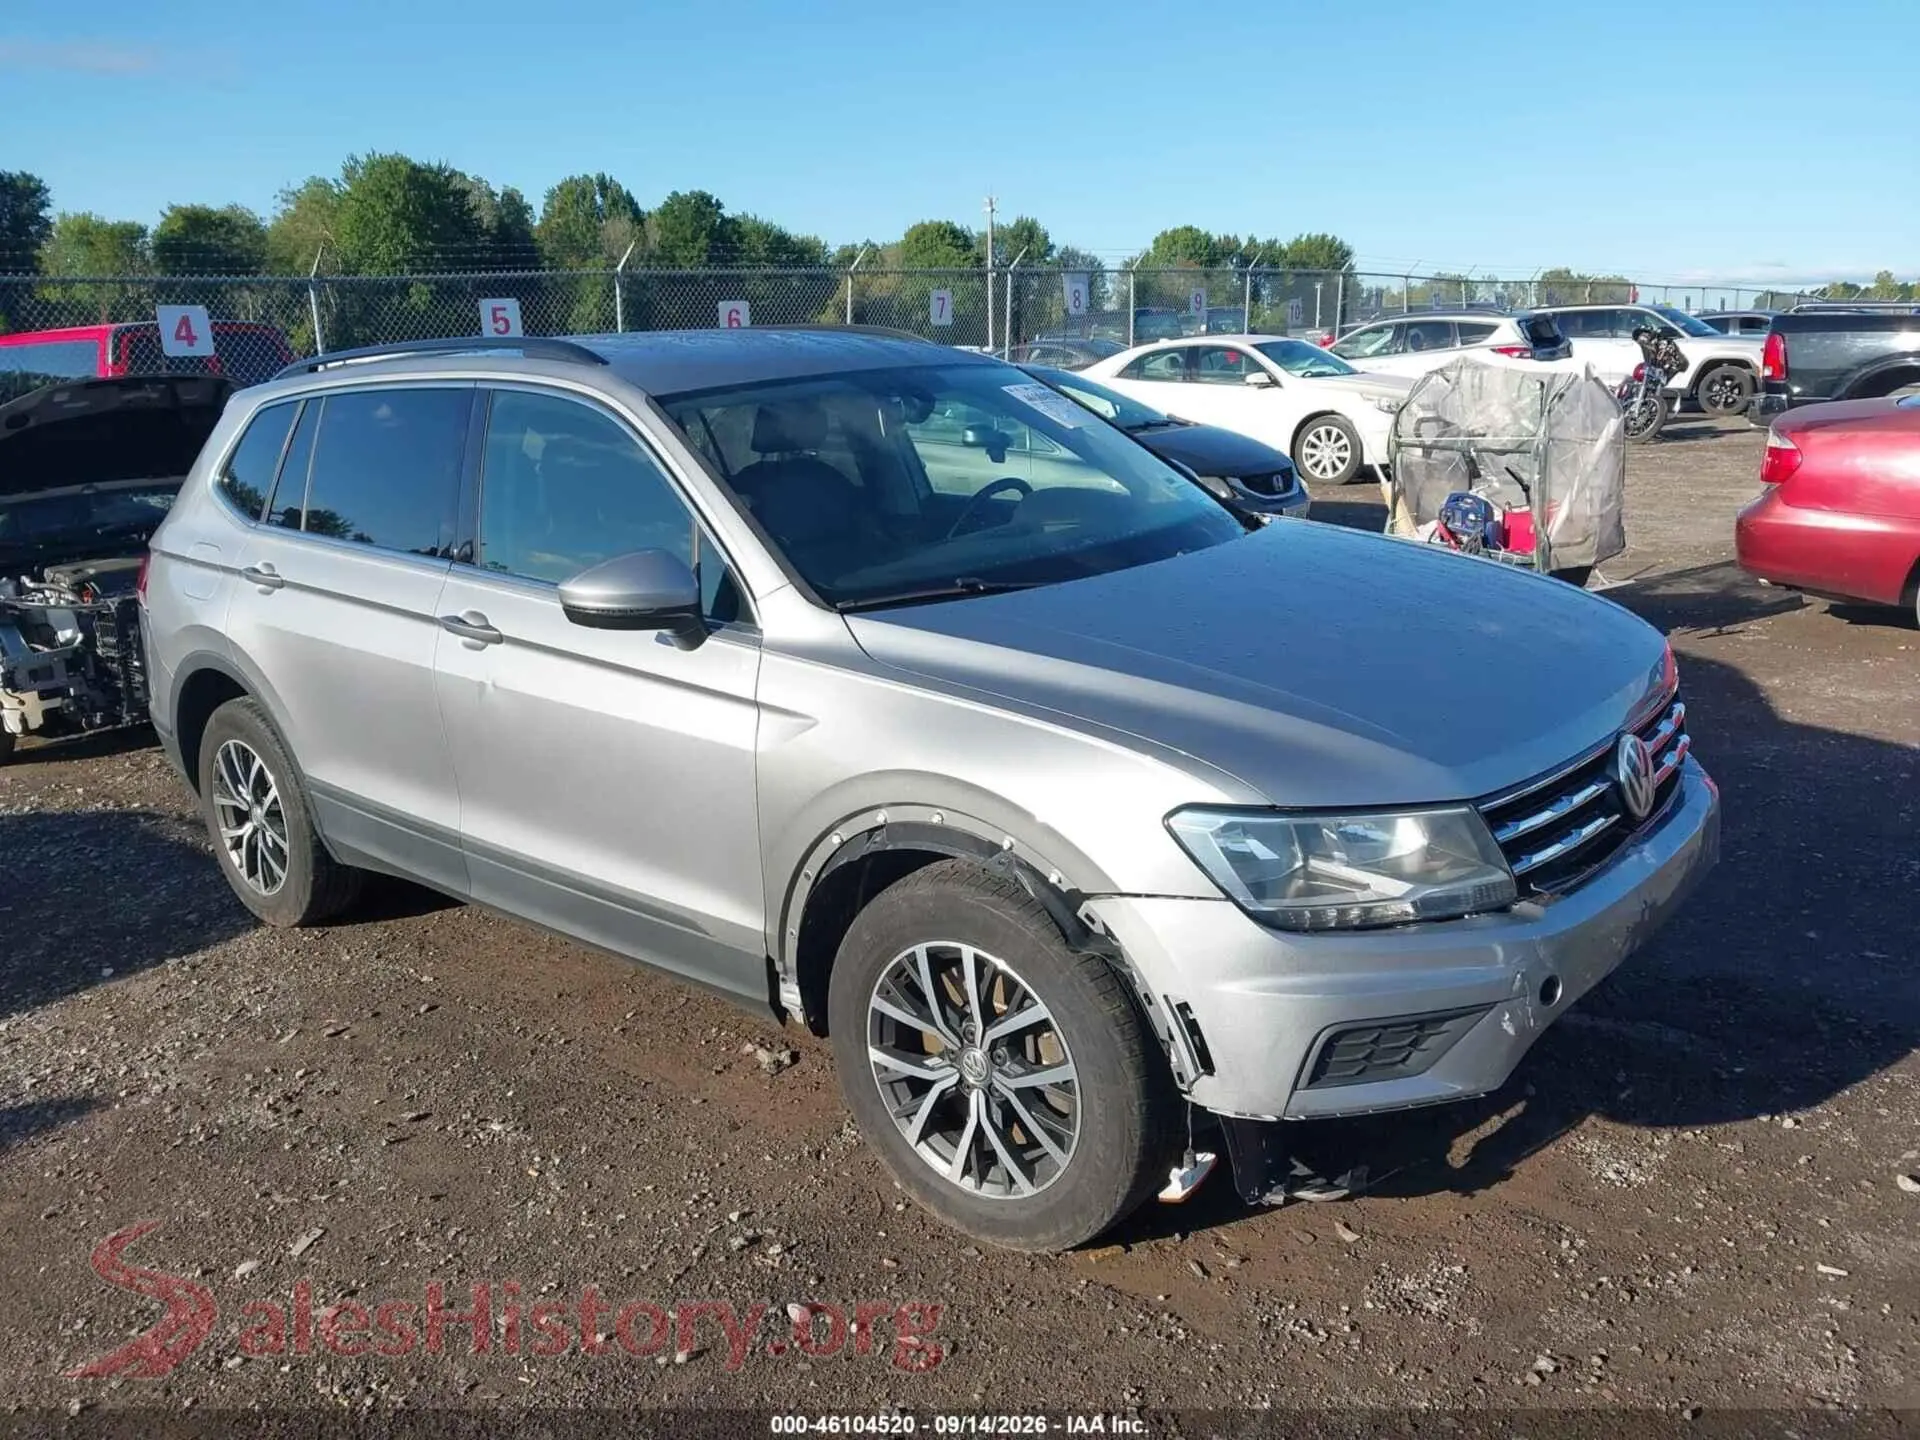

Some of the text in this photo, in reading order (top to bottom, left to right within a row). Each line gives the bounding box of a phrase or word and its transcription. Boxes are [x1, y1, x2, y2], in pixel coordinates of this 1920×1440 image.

[936, 296, 946, 319] 7
[1073, 289, 1081, 309] 8
[1194, 292, 1202, 312] 9
[491, 306, 511, 335] 5
[727, 308, 742, 328] 6
[174, 314, 198, 347] 4
